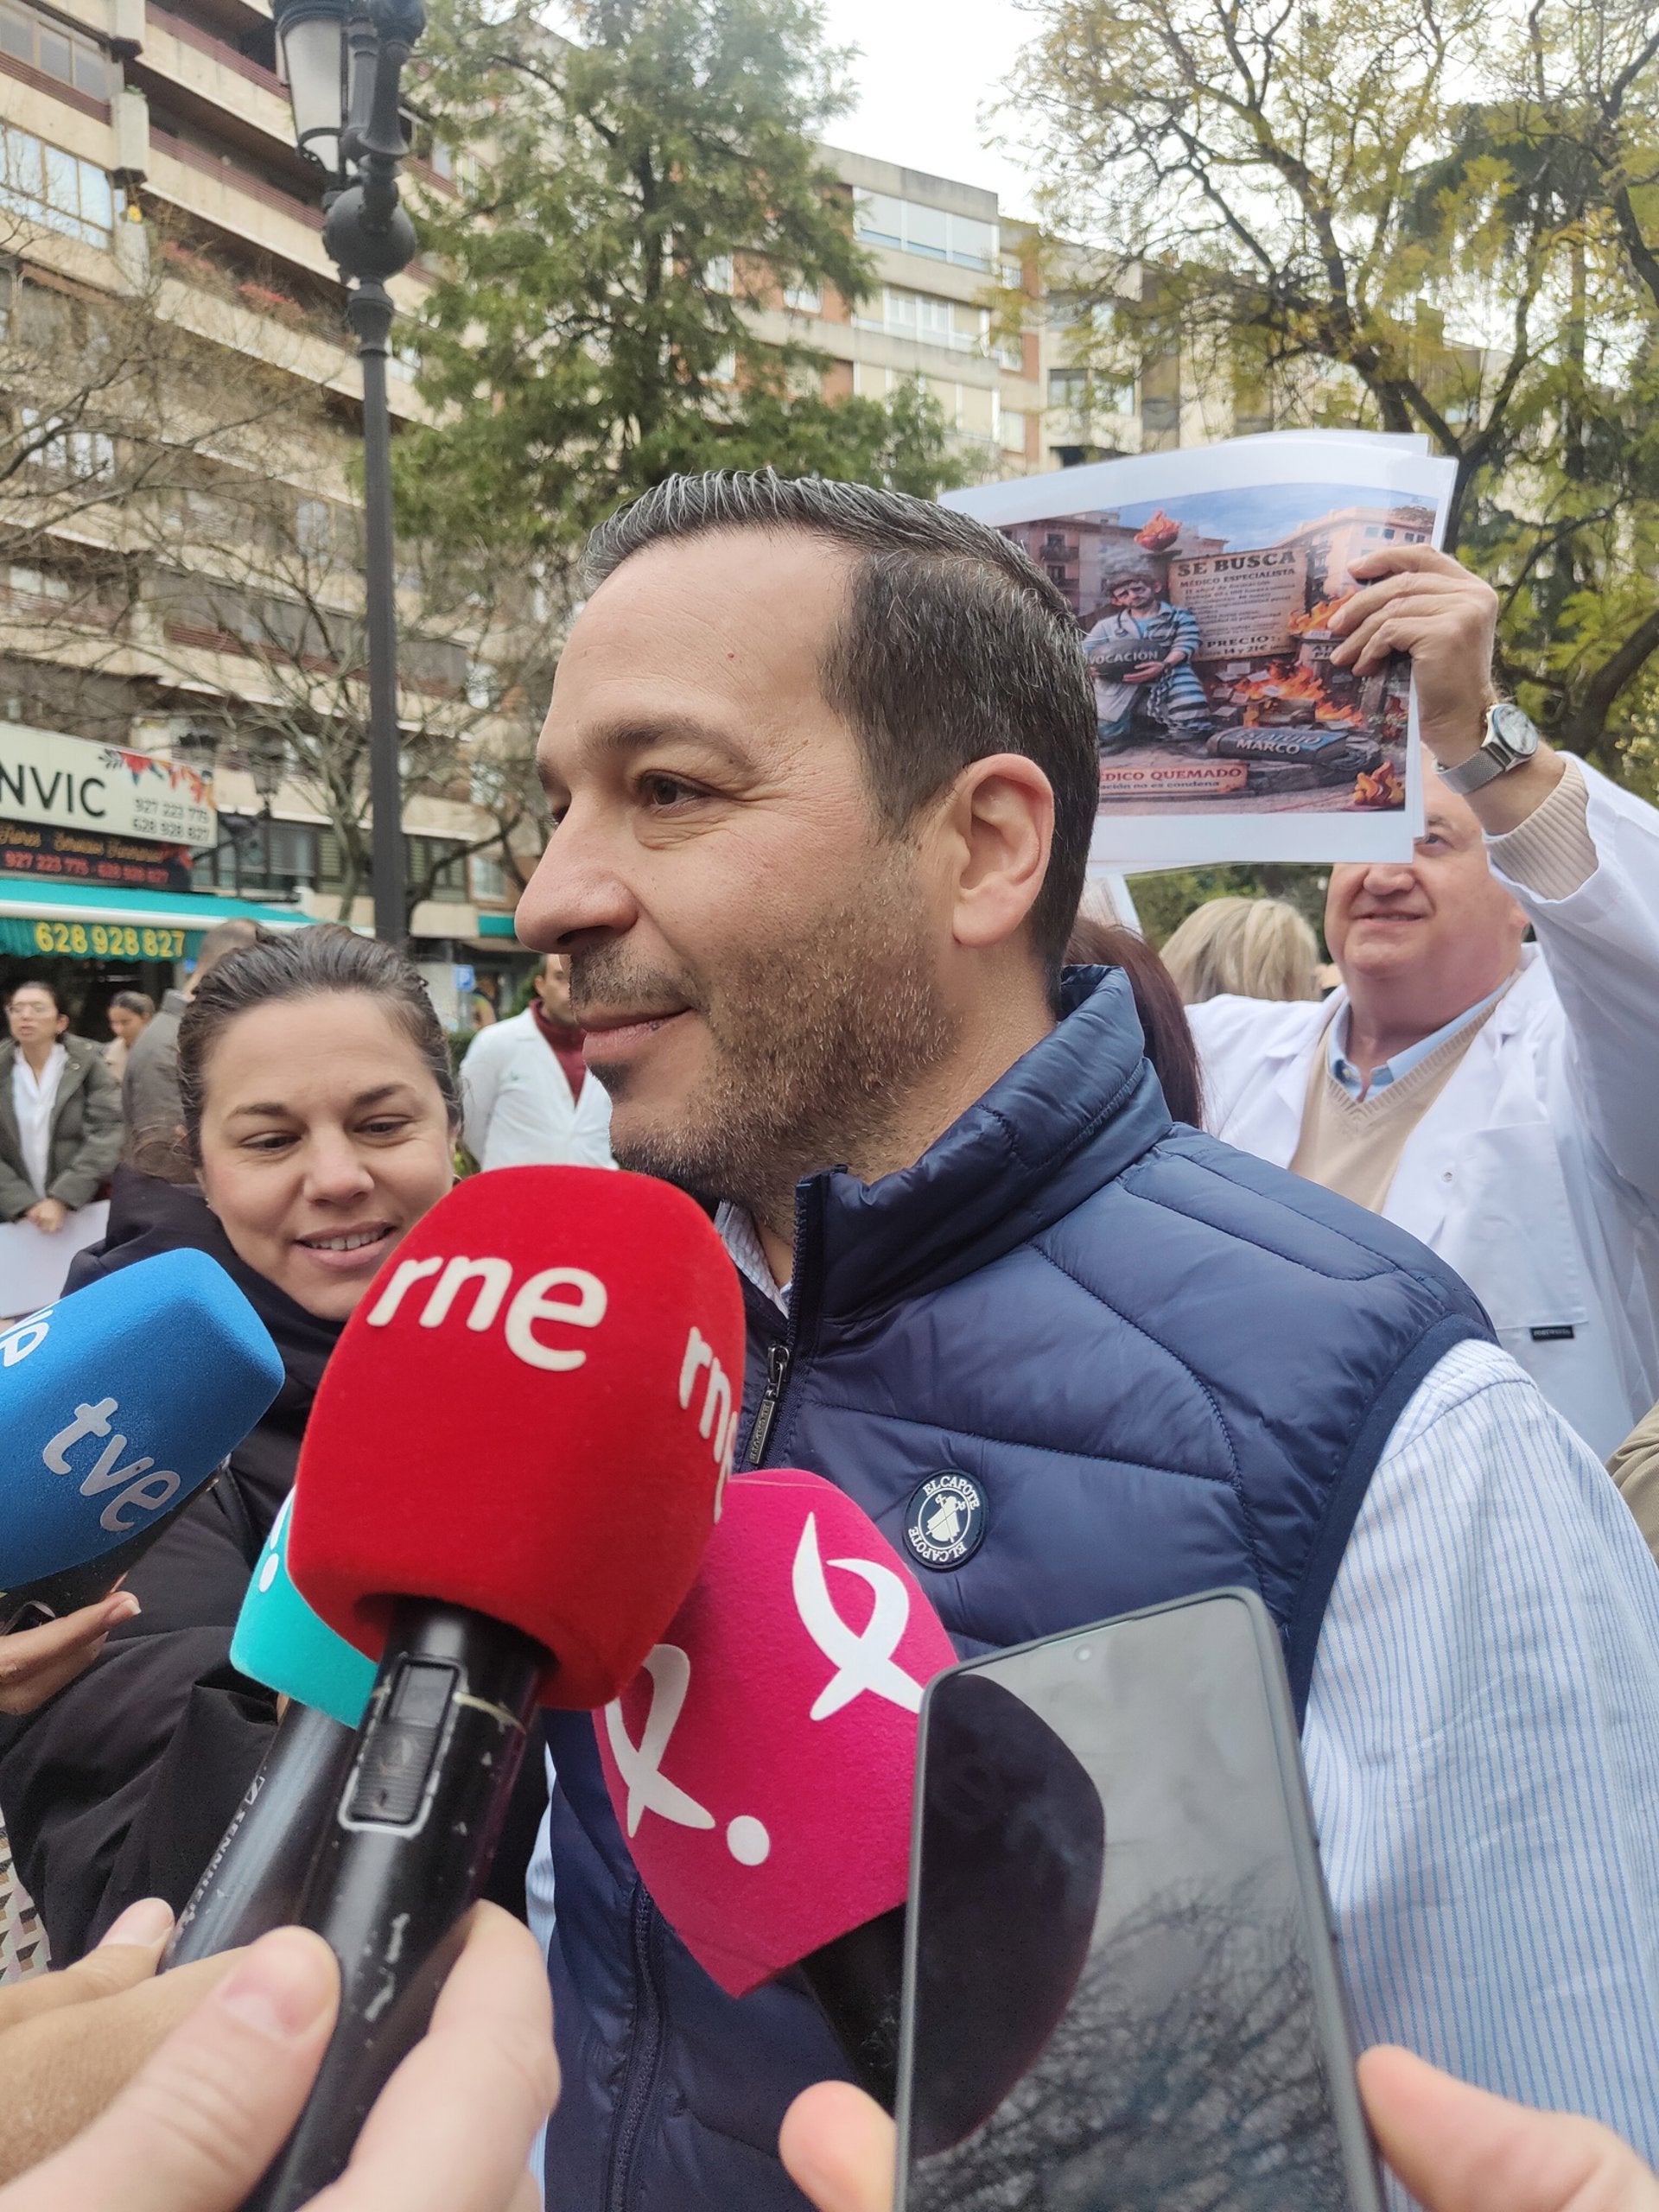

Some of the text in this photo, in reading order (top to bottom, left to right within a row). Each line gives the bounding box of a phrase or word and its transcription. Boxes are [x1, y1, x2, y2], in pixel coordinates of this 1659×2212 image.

[1178, 550, 1296, 577] SE BUSCA
[1224, 568, 1295, 583] ESPECIALISTA
[1236, 739, 1300, 754] MARCO
[1101, 768, 1242, 782] DICO QUEMADO
[35, 921, 185, 958] 628 928 827
[366, 1255, 608, 1372] rne
[43, 1397, 181, 1532] tve
